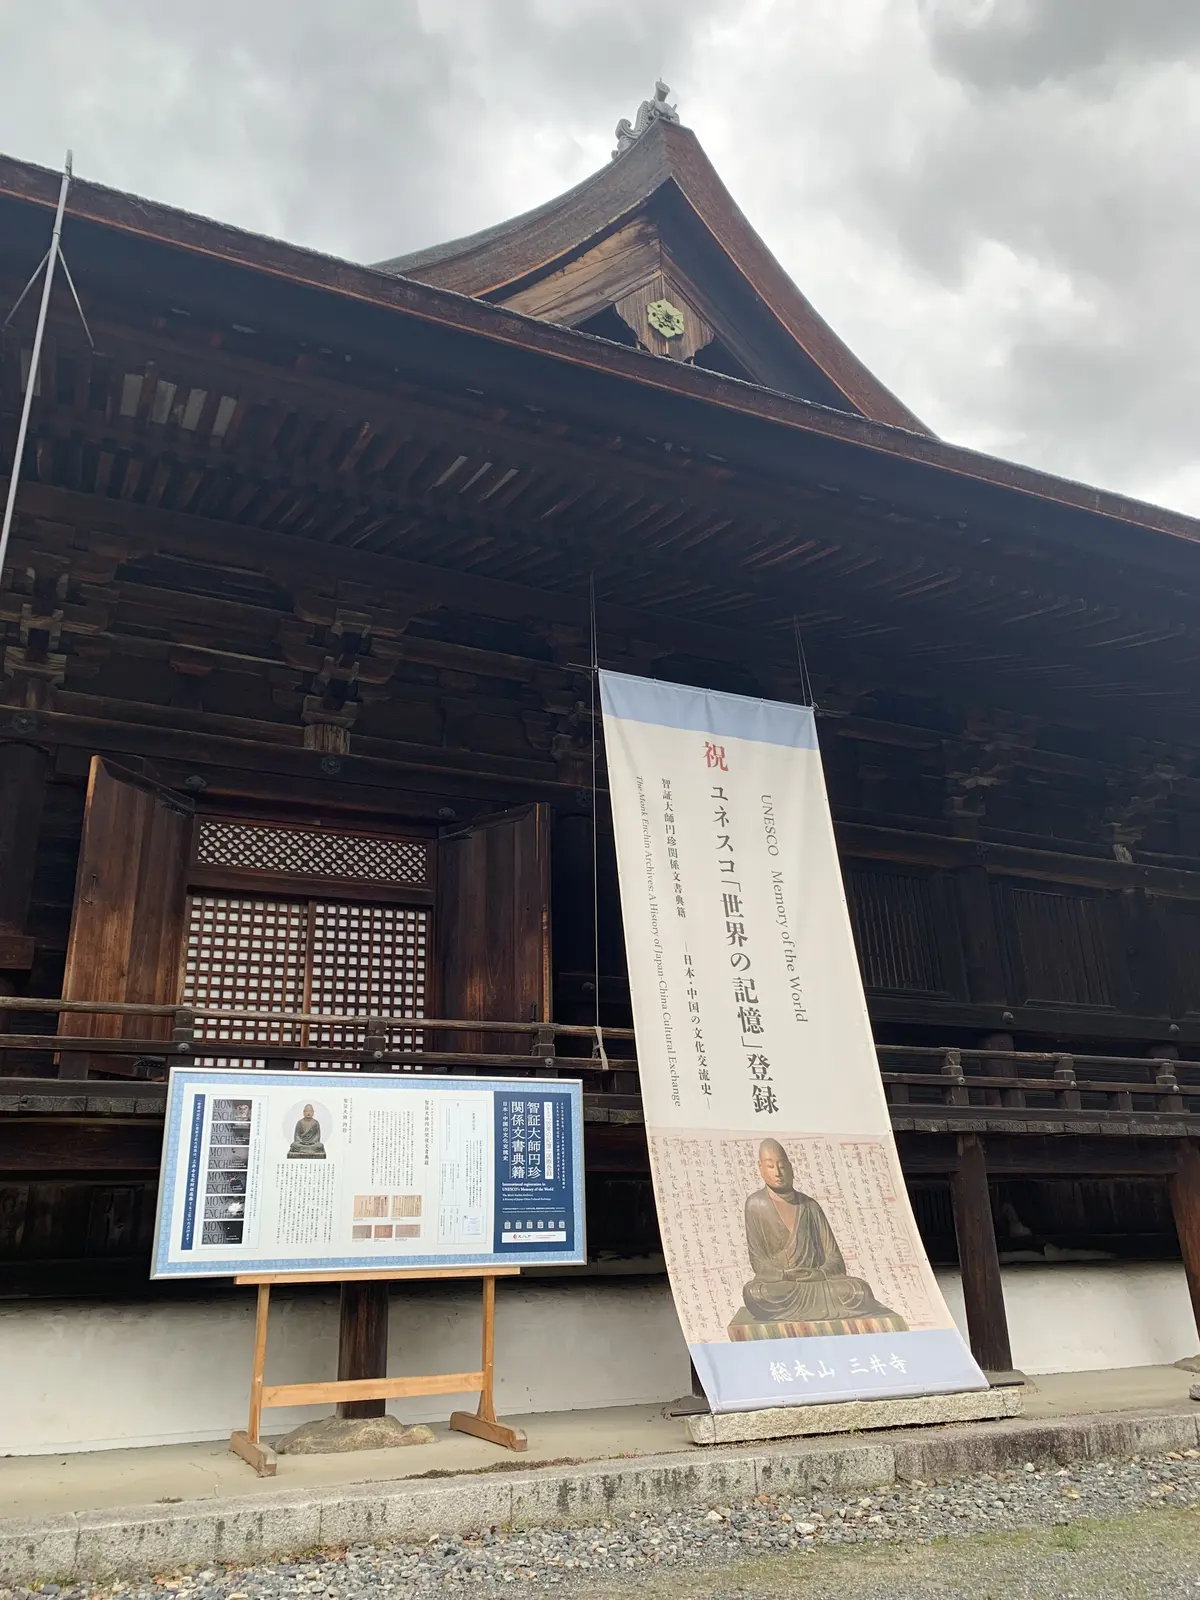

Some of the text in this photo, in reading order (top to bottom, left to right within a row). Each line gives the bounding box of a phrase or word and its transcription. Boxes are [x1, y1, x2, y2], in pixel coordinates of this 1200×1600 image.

[639, 793, 648, 816] Monk
[642, 818, 651, 849] Enchin
[645, 850, 655, 892] Archives:
[648, 893, 657, 901] A
[761, 794, 808, 1023] UNESCO Memory of the World
[650, 903, 659, 937] History
[702, 741, 779, 1115] 祝 ユネスコ「世界の記憶」登録
[654, 938, 663, 949] of
[653, 949, 669, 1010] Japan-China
[663, 1012, 676, 1054] Cultural
[668, 1056, 681, 1107] Exchange
[511, 1101, 526, 1179] 関係文書典籍
[526, 1101, 541, 1179] 智証大師円珍
[769, 1352, 908, 1384] 総本山 三井寺
